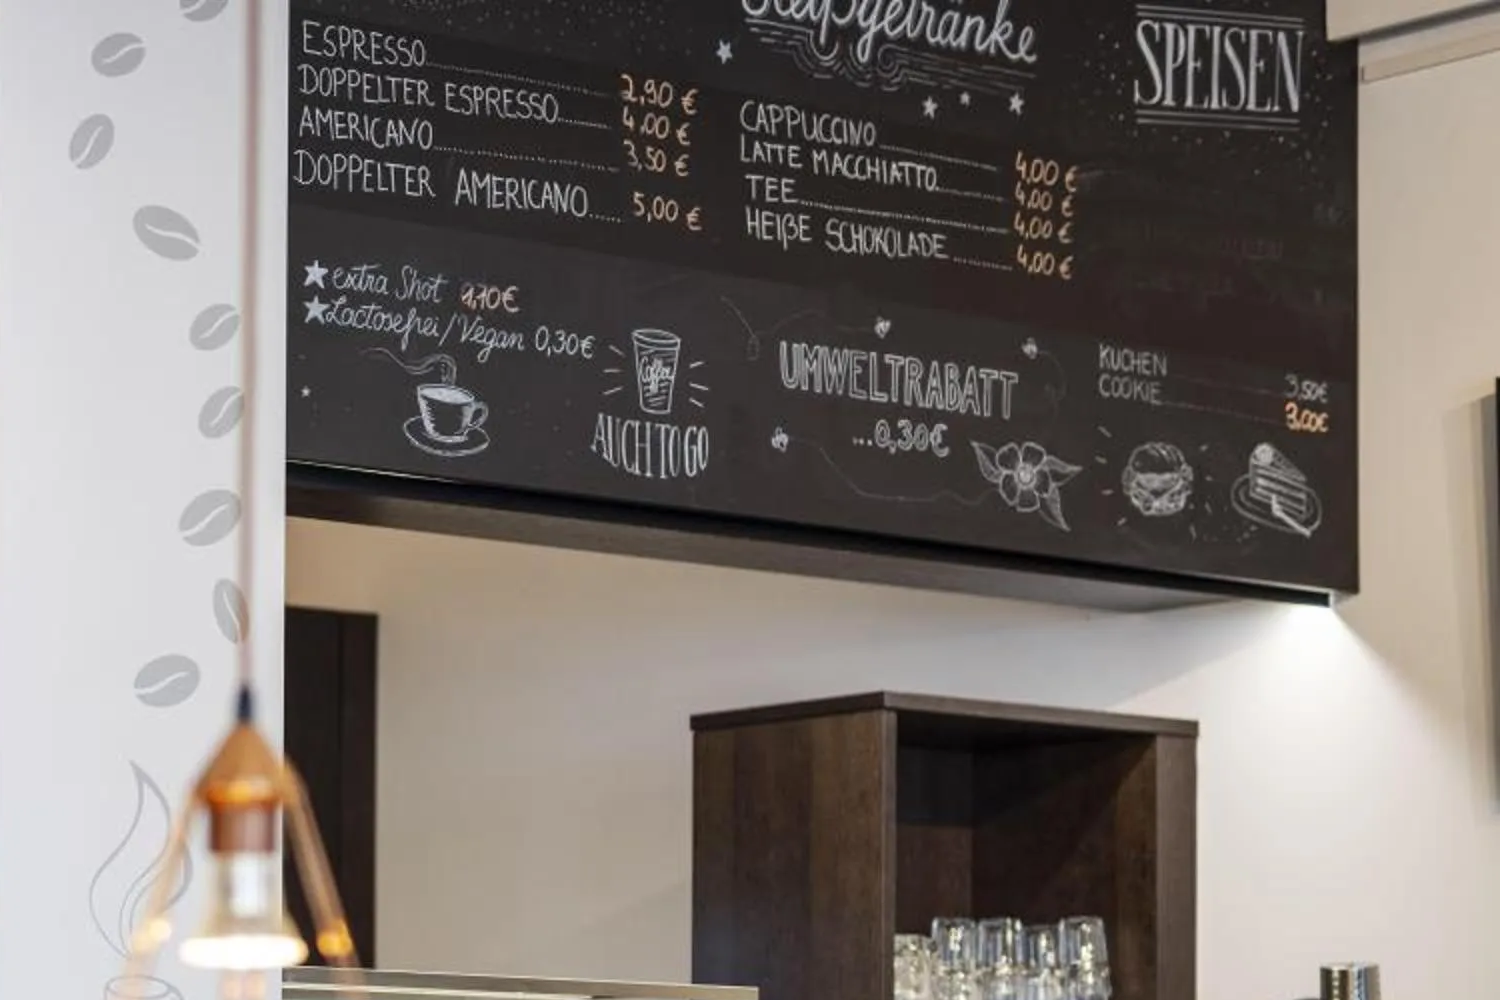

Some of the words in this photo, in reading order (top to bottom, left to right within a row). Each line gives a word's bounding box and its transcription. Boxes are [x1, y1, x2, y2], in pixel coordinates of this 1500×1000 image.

[302, 20, 425, 67] ESPRESSO
[1134, 19, 1303, 114] SPEISEN
[298, 64, 435, 107] DOPPELTER
[445, 82, 560, 124] ESPRESSO
[299, 105, 434, 150] AMERICANO
[740, 100, 877, 147] CAPPUCCINO
[293, 149, 436, 198] DOPPELTER
[454, 168, 589, 218] AMERICANO
[740, 140, 803, 170] LATTE
[812, 148, 939, 193] MACCHIATTO
[746, 174, 799, 203] TEE
[825, 214, 949, 261] SCHOKOLADE
[332, 263, 388, 293] extra
[395, 265, 449, 304] Shot
[778, 341, 1019, 421] UMWELTRABATT
[1099, 343, 1168, 377] KUCHEN
[1098, 373, 1164, 406] COOKIE
[591, 412, 652, 478] AUCH
[655, 422, 682, 479] TO
[683, 424, 709, 478] GO
